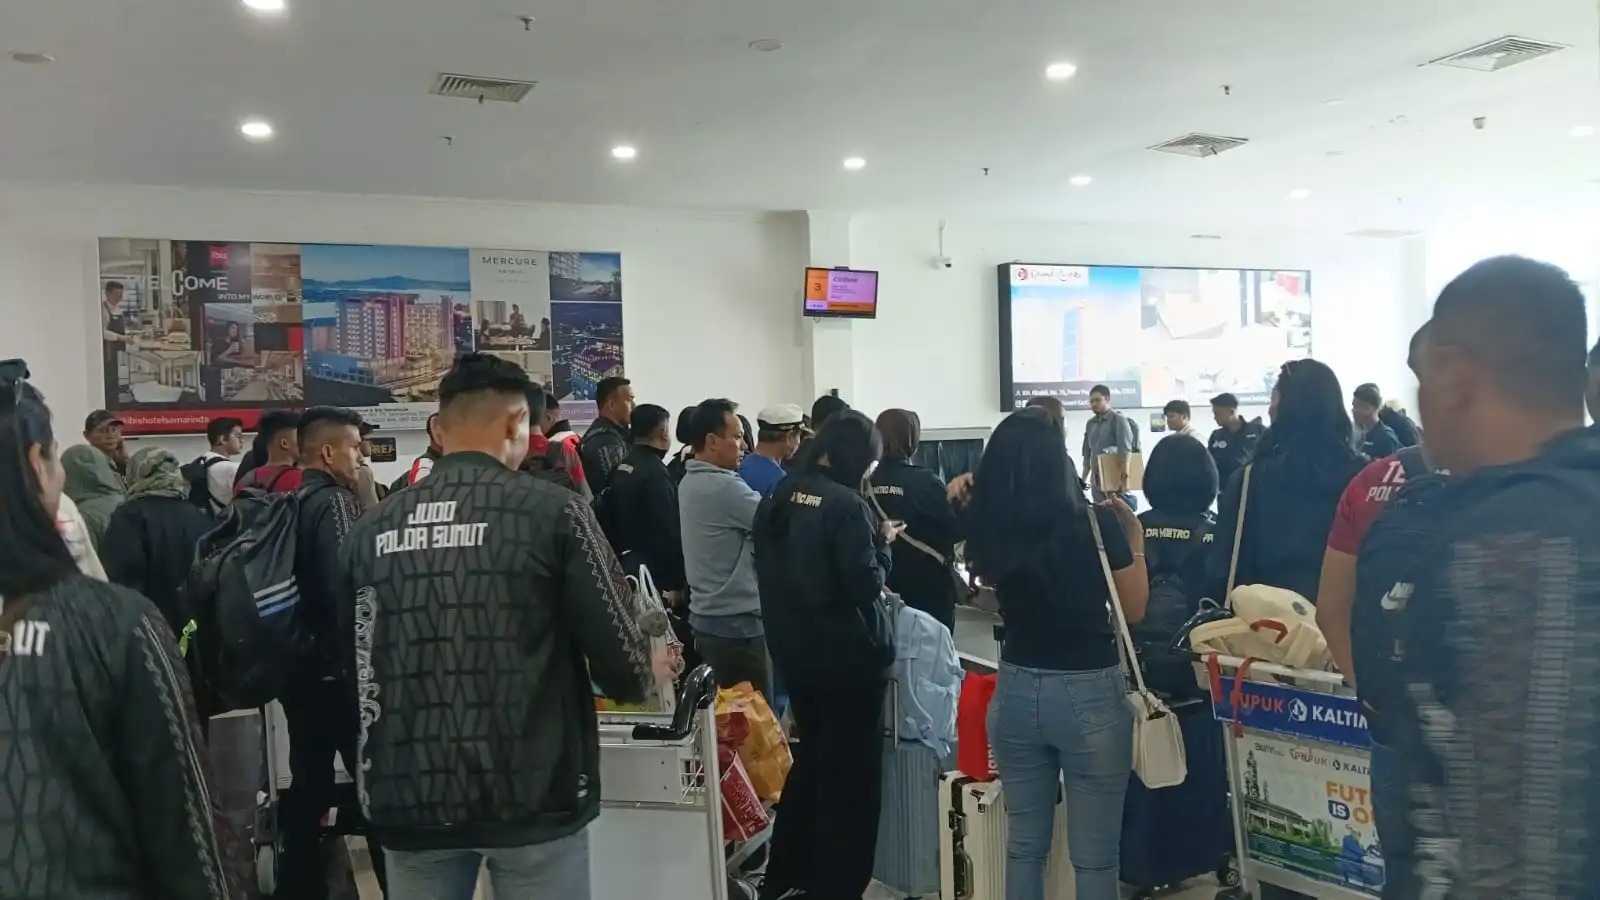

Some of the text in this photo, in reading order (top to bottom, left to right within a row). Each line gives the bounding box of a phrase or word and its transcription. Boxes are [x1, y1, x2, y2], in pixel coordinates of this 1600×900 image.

[481, 256, 537, 266] MERCURE
[814, 282, 822, 292] 3
[407, 500, 458, 525] JUDO
[375, 522, 489, 558] POLDA SUMUT
[1160, 527, 1191, 540] METRO
[1231, 691, 1285, 713] UPUK
[1332, 802, 1348, 818] IS
